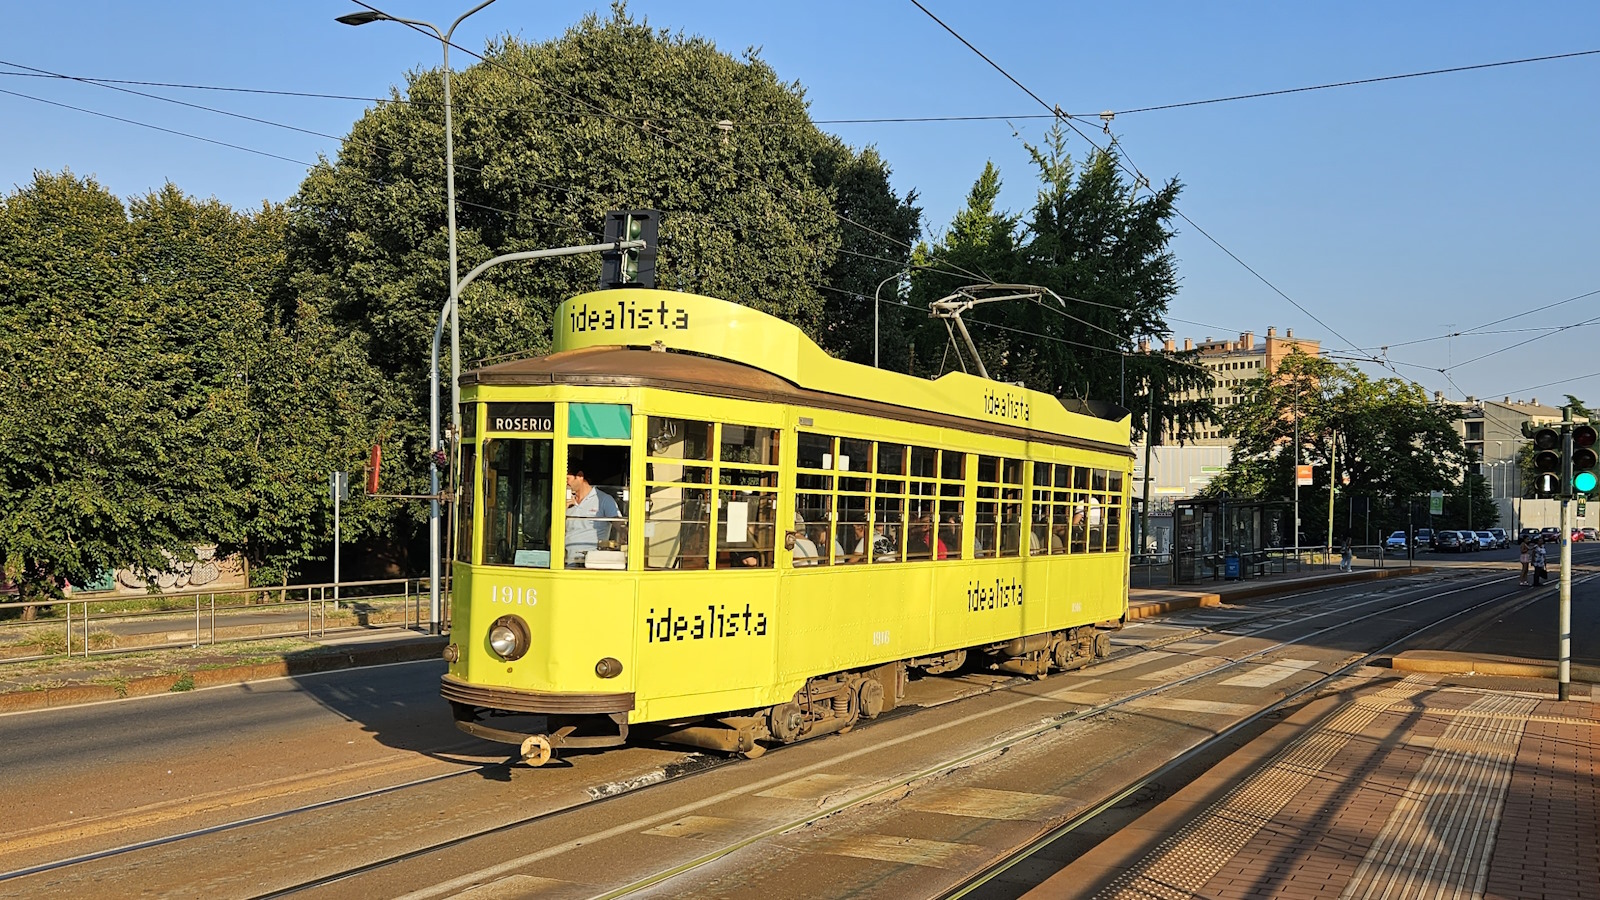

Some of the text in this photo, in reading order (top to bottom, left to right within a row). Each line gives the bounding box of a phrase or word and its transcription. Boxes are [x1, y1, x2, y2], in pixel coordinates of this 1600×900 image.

[570, 301, 689, 332] idealista
[984, 388, 1030, 421] idealista
[496, 417, 552, 431] ROSERIO
[491, 585, 538, 607] 1916
[967, 577, 1023, 612] idealista
[646, 603, 768, 643] idealista
[872, 629, 890, 646] 1916
